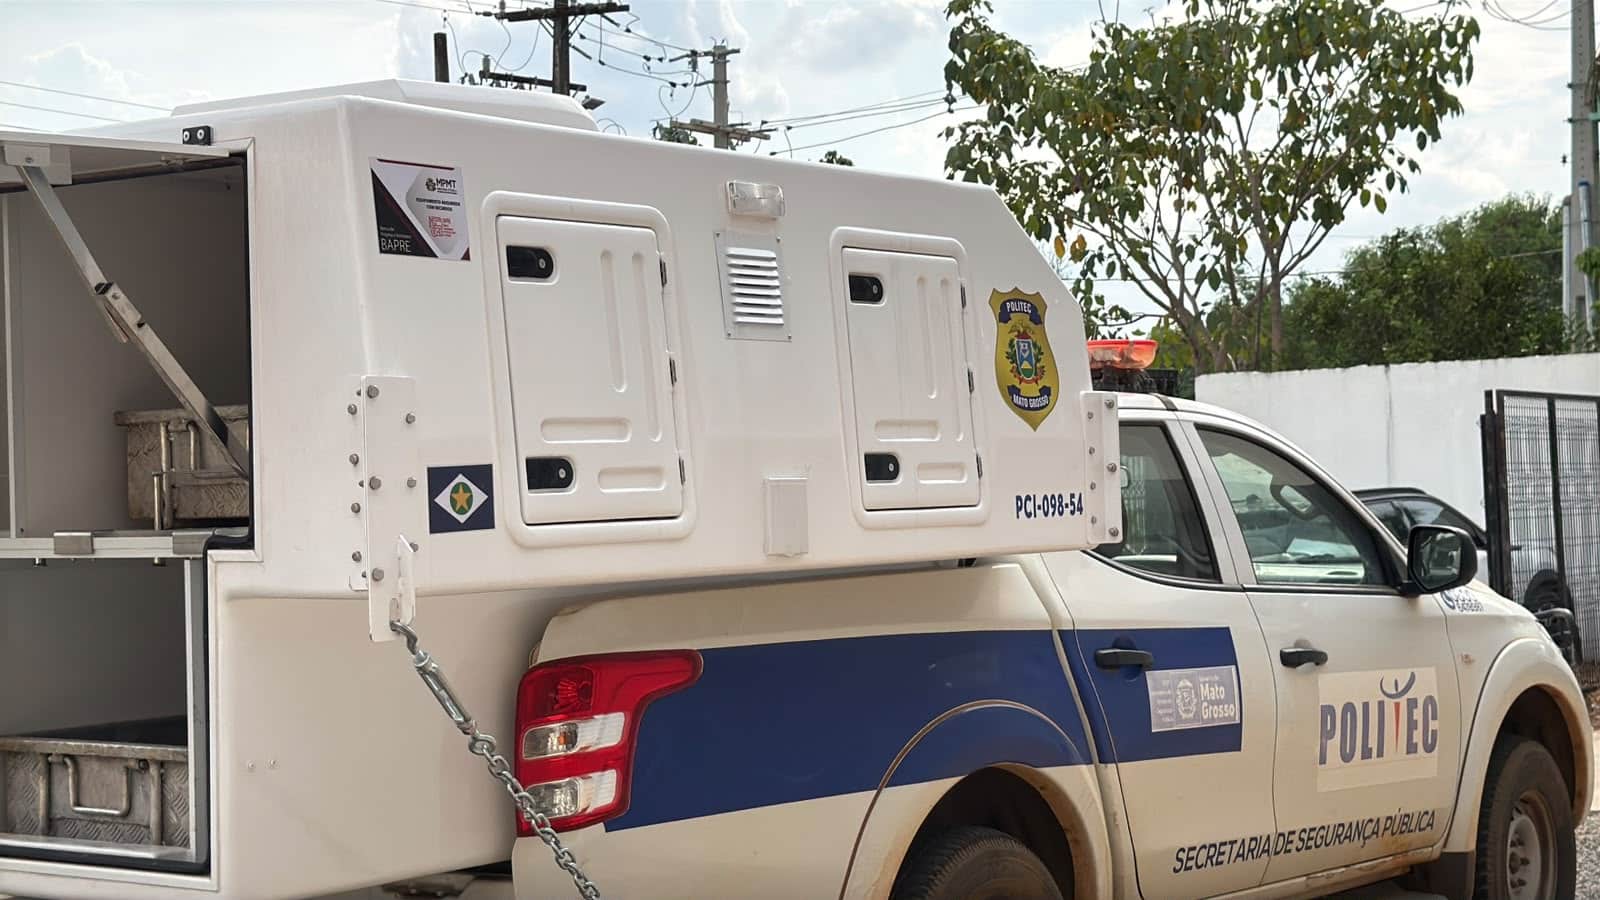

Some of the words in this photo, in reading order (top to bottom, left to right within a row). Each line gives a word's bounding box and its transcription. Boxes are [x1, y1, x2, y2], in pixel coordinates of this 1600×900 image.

[436, 178, 457, 189] MPMT
[380, 238, 412, 253] BAPRE
[1006, 301, 1032, 314] POLITEC
[1013, 394, 1029, 408] MATO
[1028, 394, 1049, 408] GROSSO
[1015, 492, 1084, 519] PCI-098-54
[1200, 683, 1225, 701] Mato
[1201, 701, 1236, 719] Grosso
[1319, 694, 1438, 766] POLITEC
[1172, 834, 1272, 874] SECRETARIA
[1273, 830, 1297, 857] DE
[1295, 816, 1381, 853] SEGURANÇA
[1382, 807, 1436, 838] PÚBLICA
